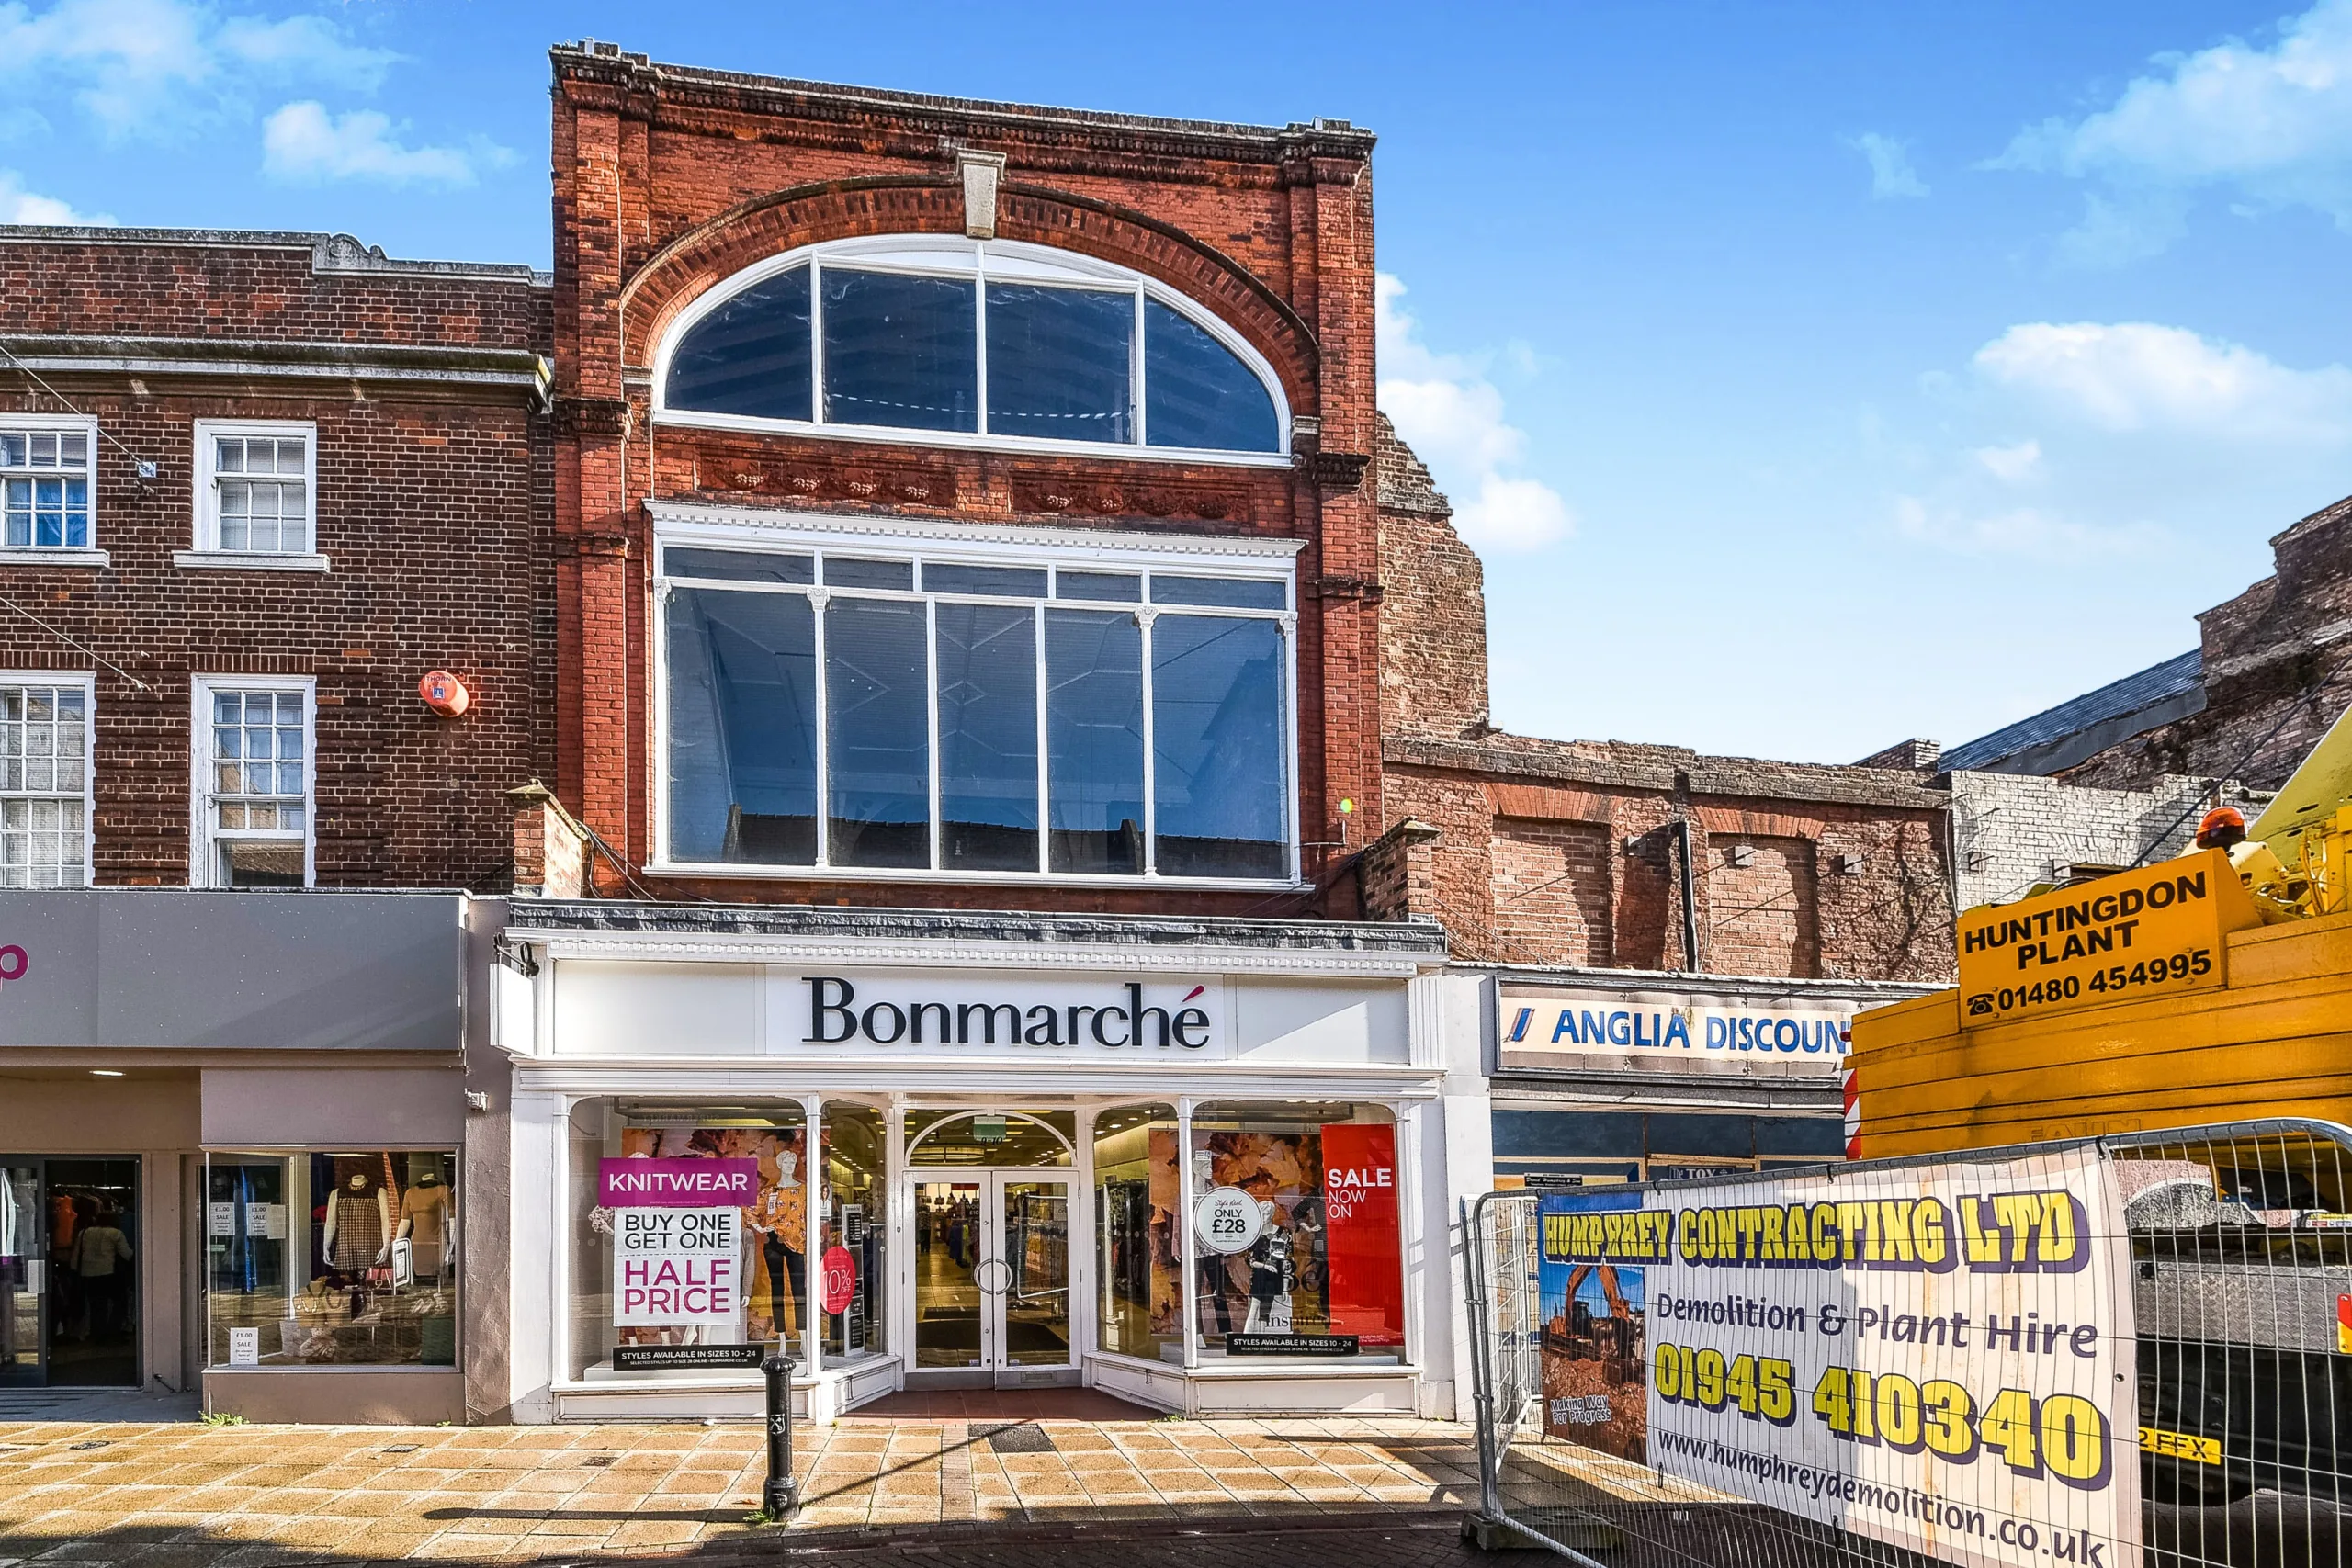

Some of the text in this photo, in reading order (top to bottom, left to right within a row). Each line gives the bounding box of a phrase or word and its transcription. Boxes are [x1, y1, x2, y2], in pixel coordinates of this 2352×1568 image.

[1965, 871, 2206, 953] HUNTINGDON
[2018, 919, 2140, 970] PLANT
[1998, 949, 2211, 1010] 01480 454995
[801, 976, 1211, 1049] Bonmarché
[1551, 1010, 1850, 1054] ANGLIA DISCOUN
[609, 1173, 748, 1192] KNITWEAR
[1328, 1168, 1392, 1188] SALE
[1329, 1190, 1366, 1203] NOW
[625, 1214, 731, 1231] BUY ONE
[1214, 1209, 1242, 1218] ONLY
[1329, 1204, 1351, 1218] ON
[1212, 1219, 1246, 1234] £28
[1544, 1190, 2086, 1271] HUMPHREY CONTRACTING LTD
[625, 1233, 731, 1249] GET ONE
[625, 1259, 731, 1286] HALF
[822, 1269, 852, 1294] 10%
[625, 1288, 731, 1314] PRICE
[1657, 1293, 2098, 1358] Demolition & Plant Hire
[653, 1350, 695, 1359] AVAILABLE
[1550, 1395, 1608, 1413] Making Way
[1655, 1342, 2110, 1489] 01945 410340
[1553, 1408, 1611, 1426] For Progress
[1658, 1430, 2106, 1568] www.humphreydemolition.co.uk
